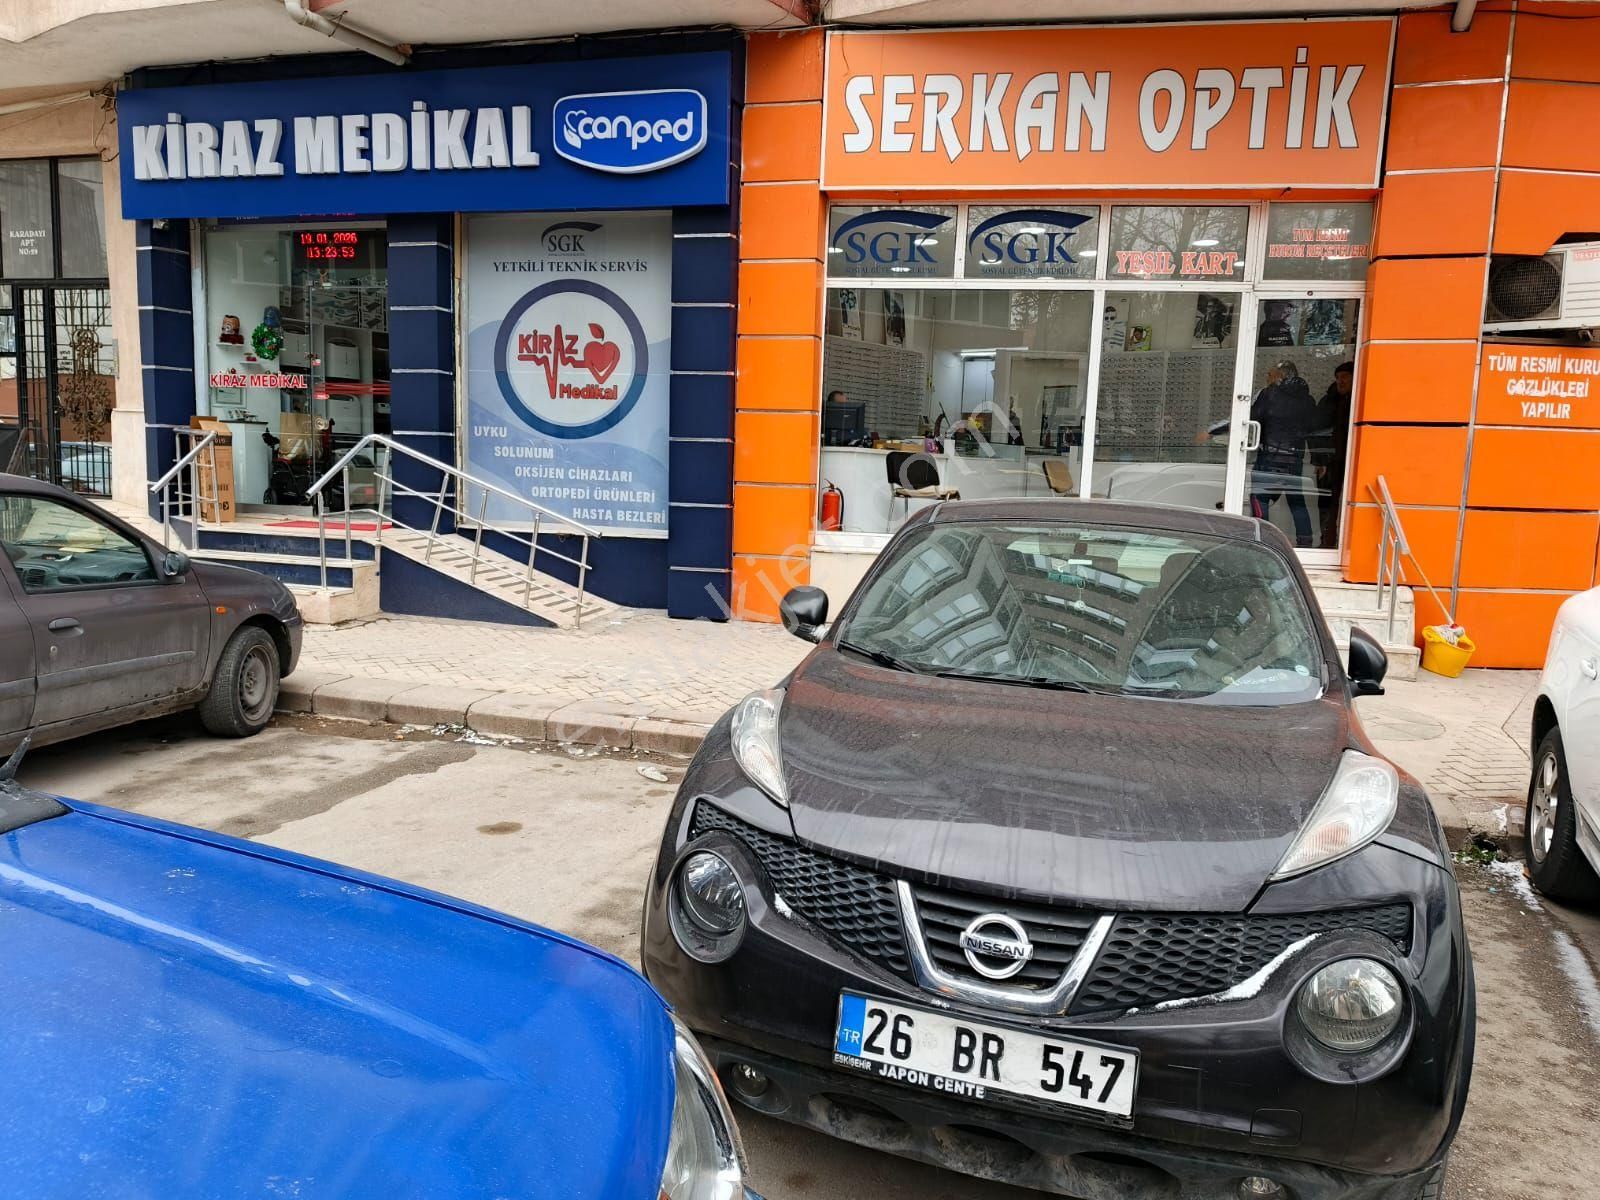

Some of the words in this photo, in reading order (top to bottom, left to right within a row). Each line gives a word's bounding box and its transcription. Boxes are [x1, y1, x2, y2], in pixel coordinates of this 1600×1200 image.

[843, 71, 1111, 163] SERKAN
[1138, 46, 1366, 152] OPTİK
[577, 111, 694, 150] canped
[132, 112, 284, 180] KİRAZ
[294, 100, 540, 174] MEDİKAL
[20, 239, 35, 247] APT
[300, 232, 357, 245] 19.01.2026
[547, 234, 586, 252] SGK
[845, 231, 938, 263] SGK
[982, 231, 1078, 263] SGK
[308, 246, 355, 258] 13:23:53
[493, 259, 545, 272] YETKİLİ
[547, 259, 599, 272] TEKNİK
[600, 259, 648, 272] SERVİS
[1115, 248, 1176, 279] YEŞİL
[1180, 251, 1238, 275] KART
[518, 325, 579, 354] KİRAZ
[1488, 352, 1518, 371] TÜM
[1520, 354, 1562, 374] RESMİ
[1565, 358, 1600, 375] KURU
[209, 371, 247, 388] KİRAZ
[249, 371, 308, 388] MEDİKAL
[1506, 376, 1590, 397] GÖZLÜKLERİ
[559, 383, 618, 400] Medikal
[1521, 402, 1571, 418] YAPILIR
[474, 426, 508, 438] UYKU
[494, 446, 554, 459] SOLUNUM
[514, 465, 565, 479] OKSİJEN
[568, 466, 633, 482] CİHAZLARI
[531, 485, 590, 500] ORTOPEDİ
[593, 486, 656, 503] ÜRÜNLERİ
[572, 507, 613, 521] HASTA
[616, 509, 667, 524] BEZLERİ
[966, 937, 1025, 957] NISSAN
[842, 1028, 861, 1044] TR
[834, 1054, 872, 1071] ESKİŞEHİR
[863, 1008, 915, 1060] 26
[952, 1026, 1005, 1082] BR
[1040, 1044, 1125, 1103] 547
[878, 1064, 929, 1087] JAPON
[934, 1076, 985, 1099] CENTE
